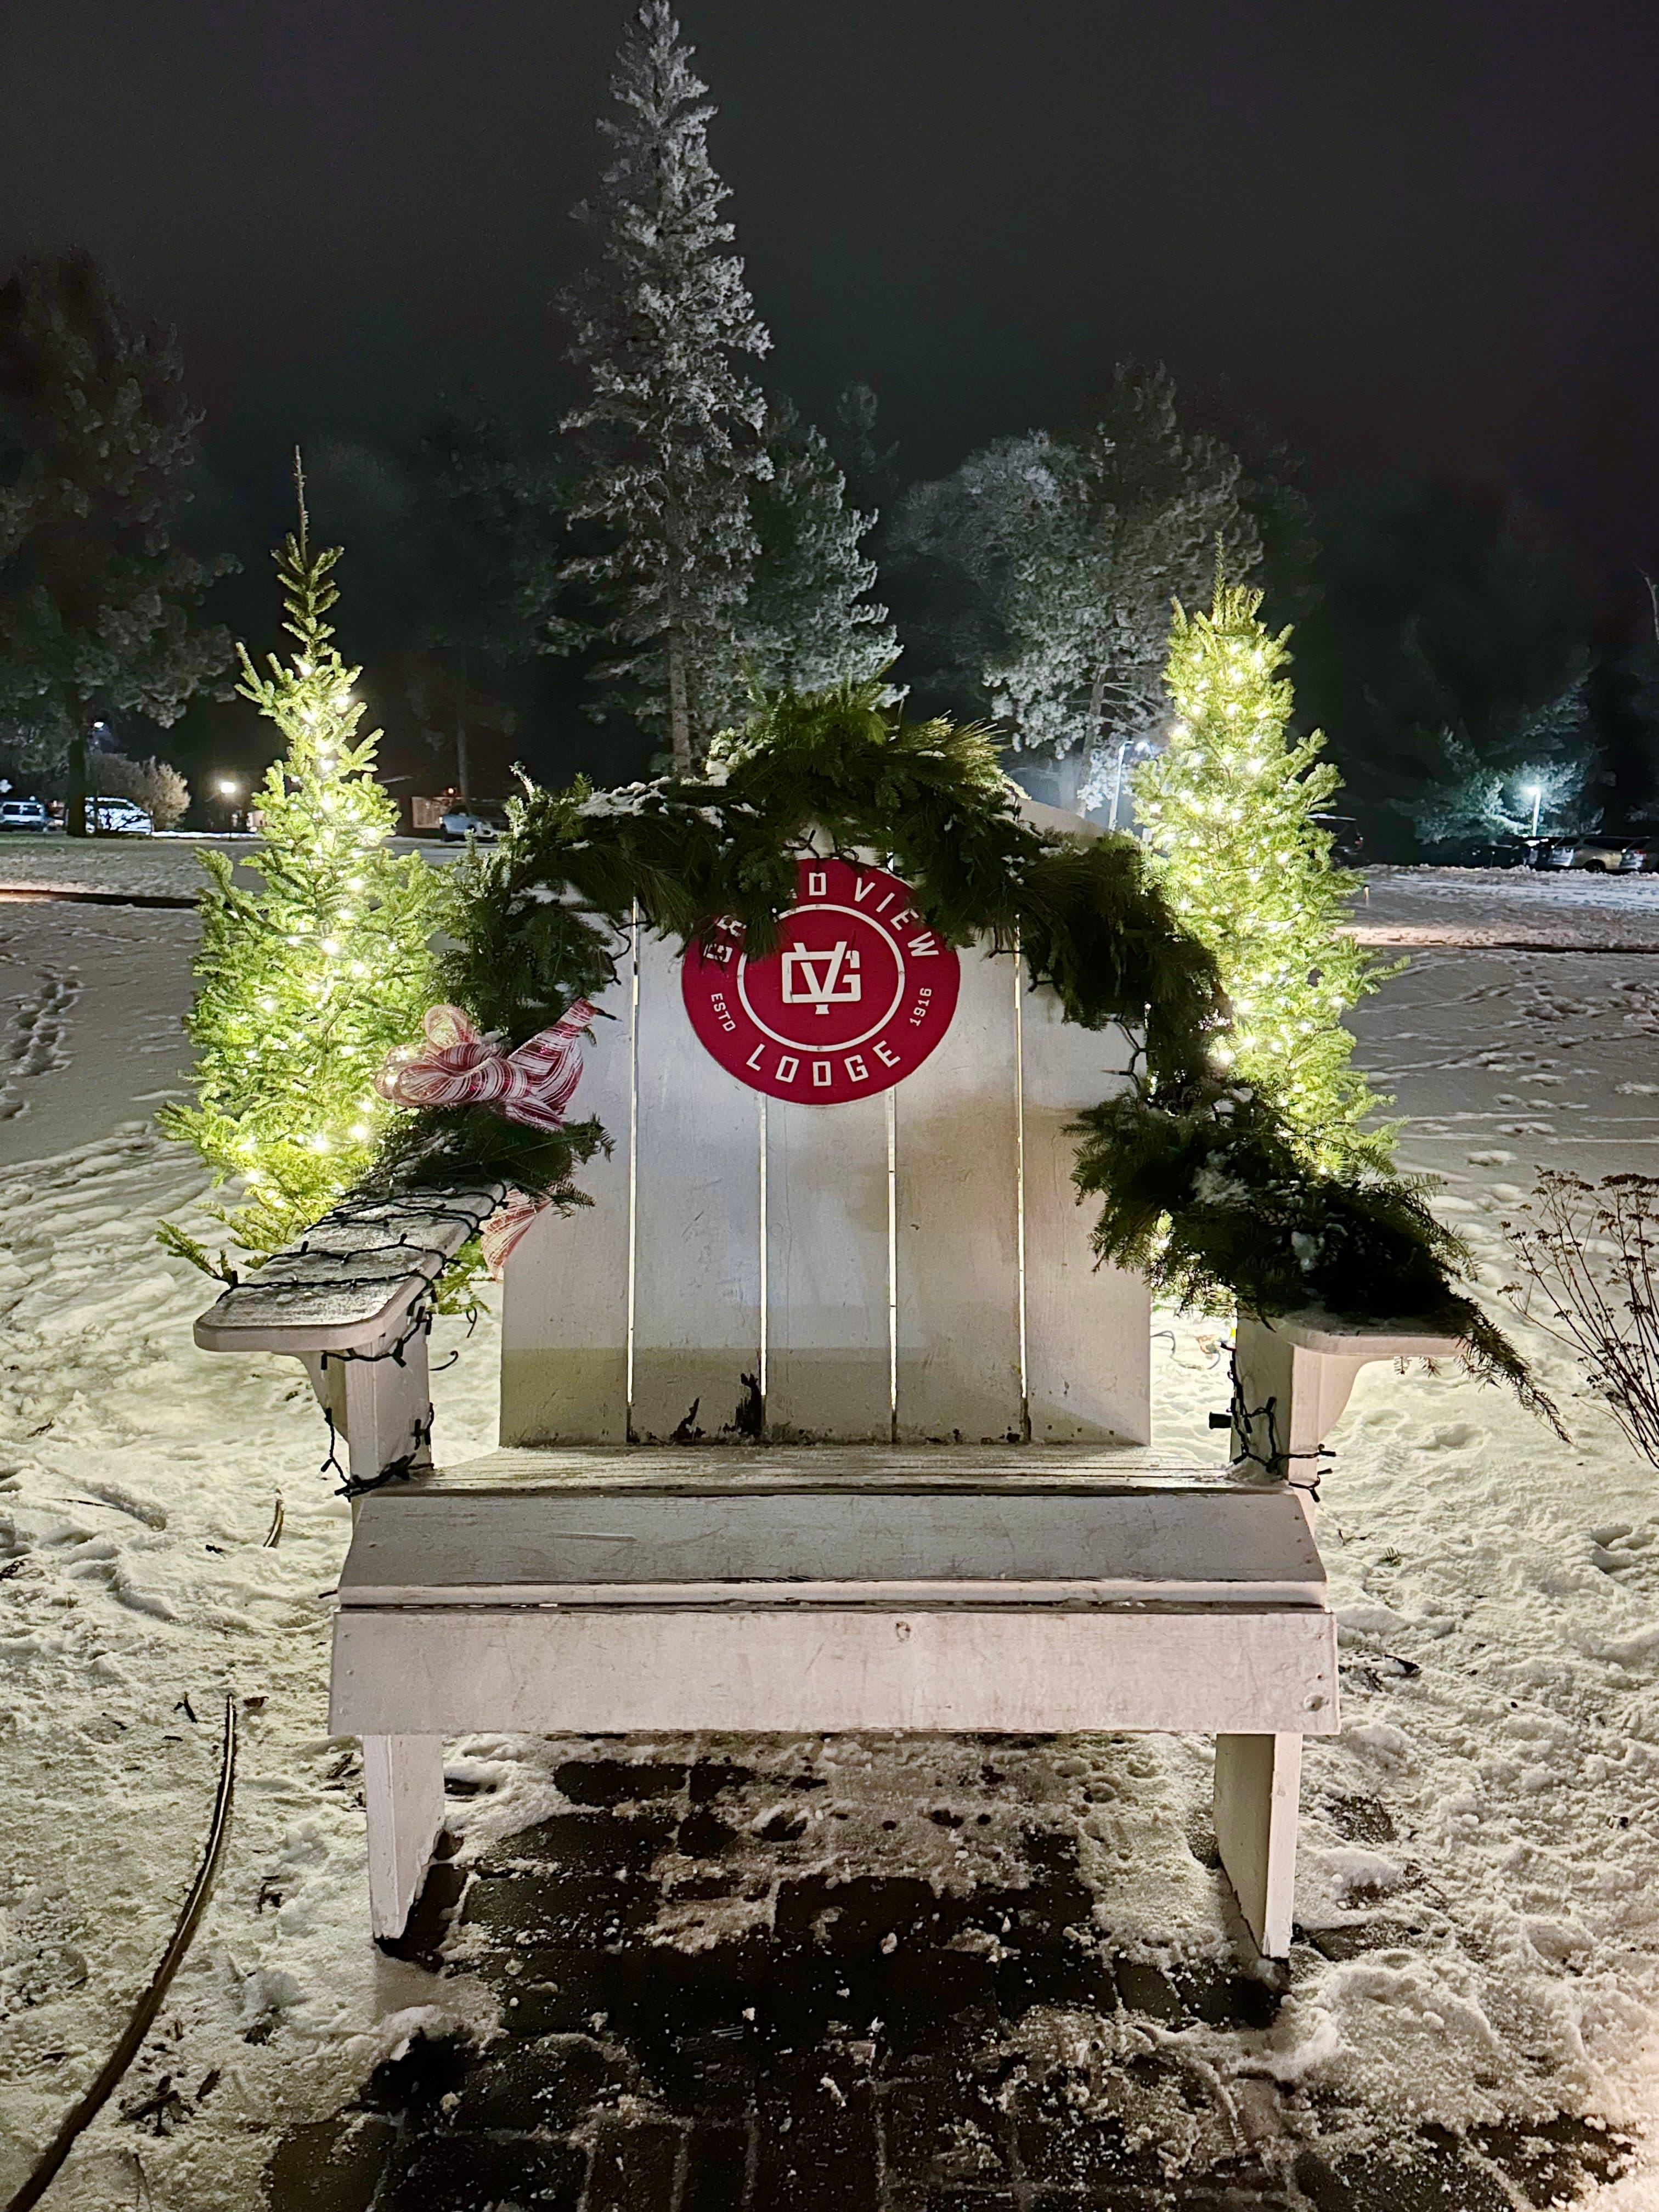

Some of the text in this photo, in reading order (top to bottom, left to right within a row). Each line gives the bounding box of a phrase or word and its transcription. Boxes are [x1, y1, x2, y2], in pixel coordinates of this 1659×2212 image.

[854, 877, 939, 957] VIEW
[710, 992, 736, 1032] ESTD
[909, 987, 932, 1026] 1916
[746, 1040, 901, 1086] LODGE
